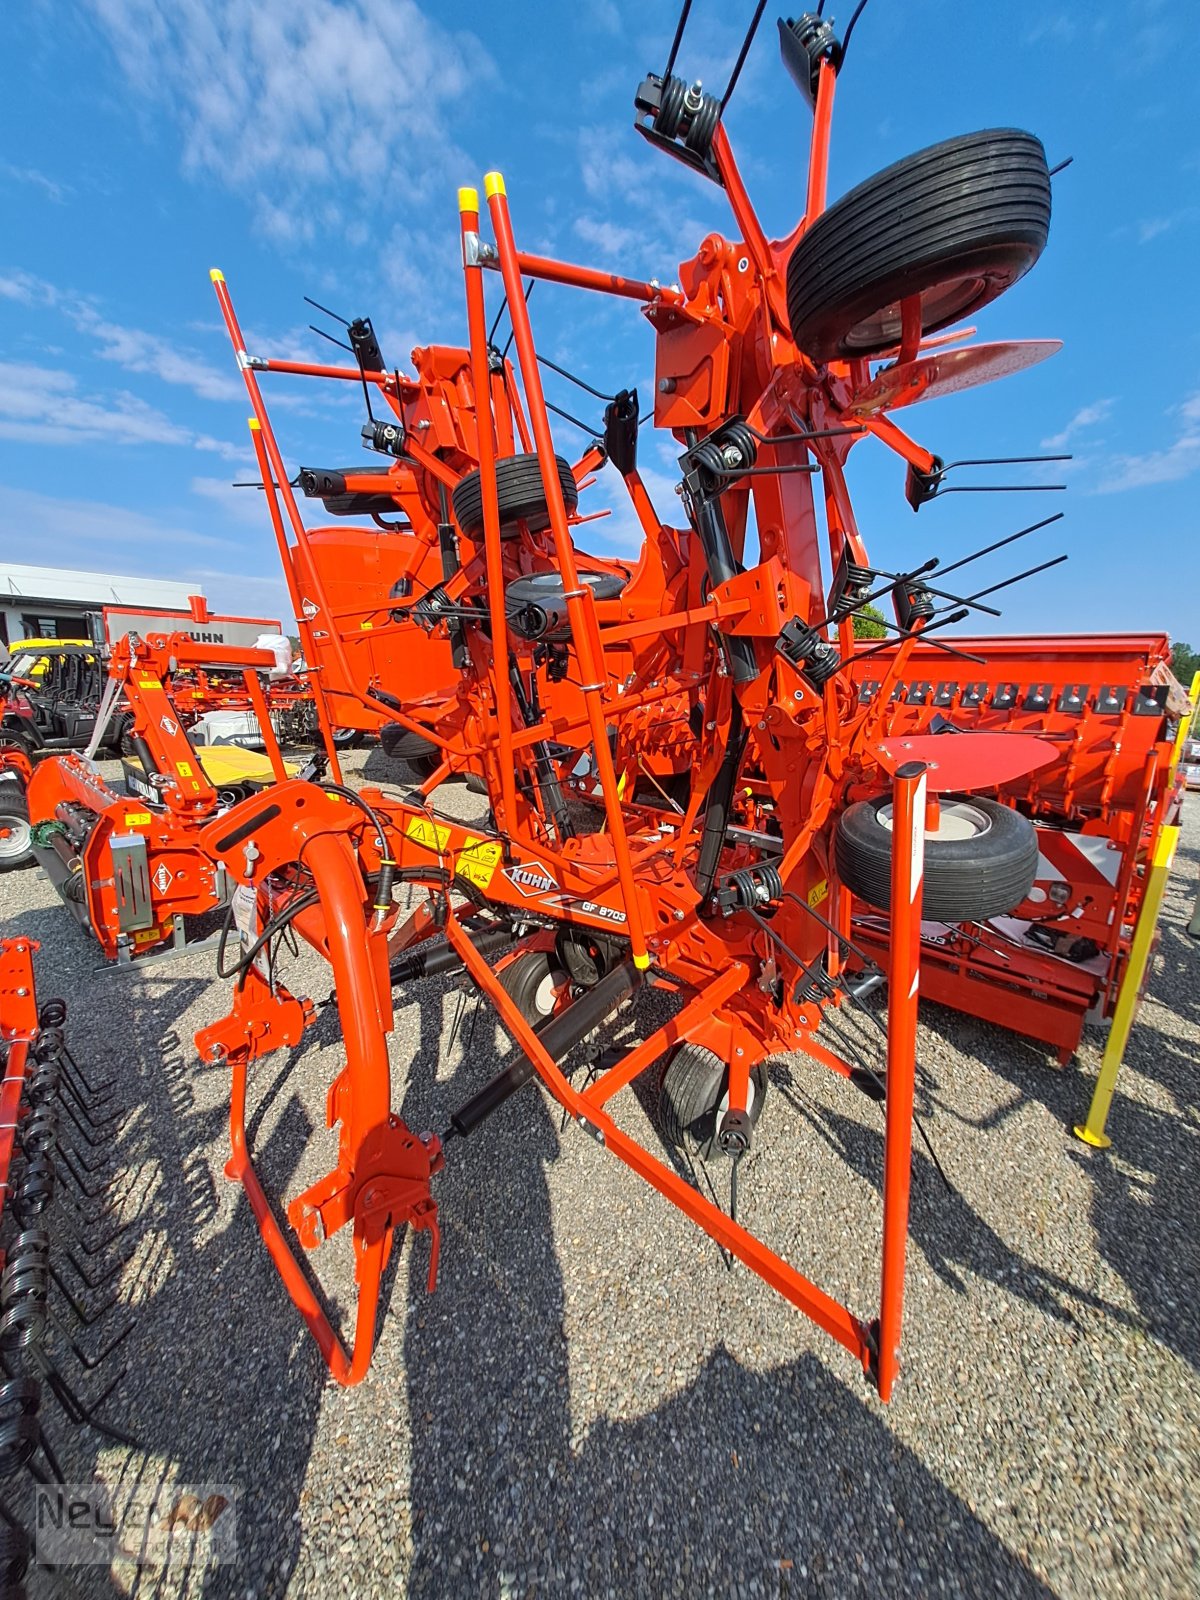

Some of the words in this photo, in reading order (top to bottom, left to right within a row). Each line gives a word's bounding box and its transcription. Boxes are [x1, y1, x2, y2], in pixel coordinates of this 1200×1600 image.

[186, 631, 223, 643] UHN
[511, 868, 552, 890] KUHN
[582, 901, 598, 912] GF
[599, 906, 626, 922] 8703
